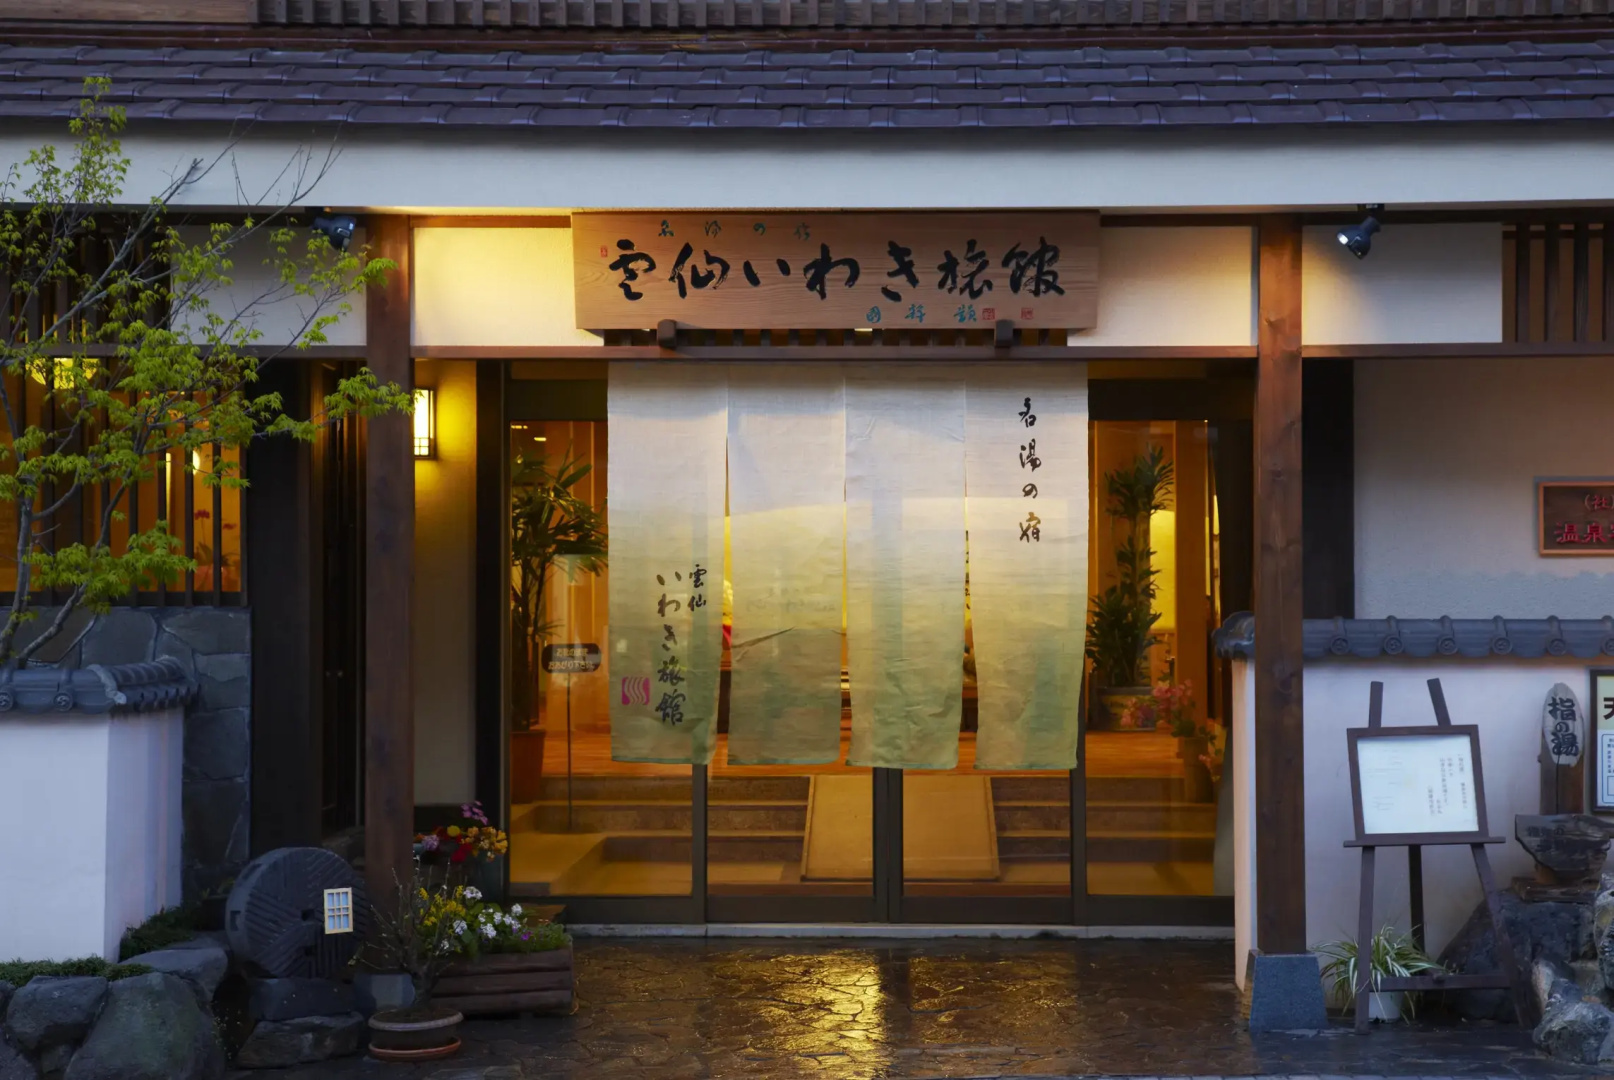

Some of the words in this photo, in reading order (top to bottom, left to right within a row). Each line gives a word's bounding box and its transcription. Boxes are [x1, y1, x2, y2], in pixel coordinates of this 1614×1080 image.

[608, 235, 1066, 302] 雲仙いわき旅館
[1018, 397, 1042, 543] 名湯の宿
[1554, 521, 1614, 544] 温泉
[689, 564, 707, 611] 雲仙
[655, 570, 687, 726] いわき旅館
